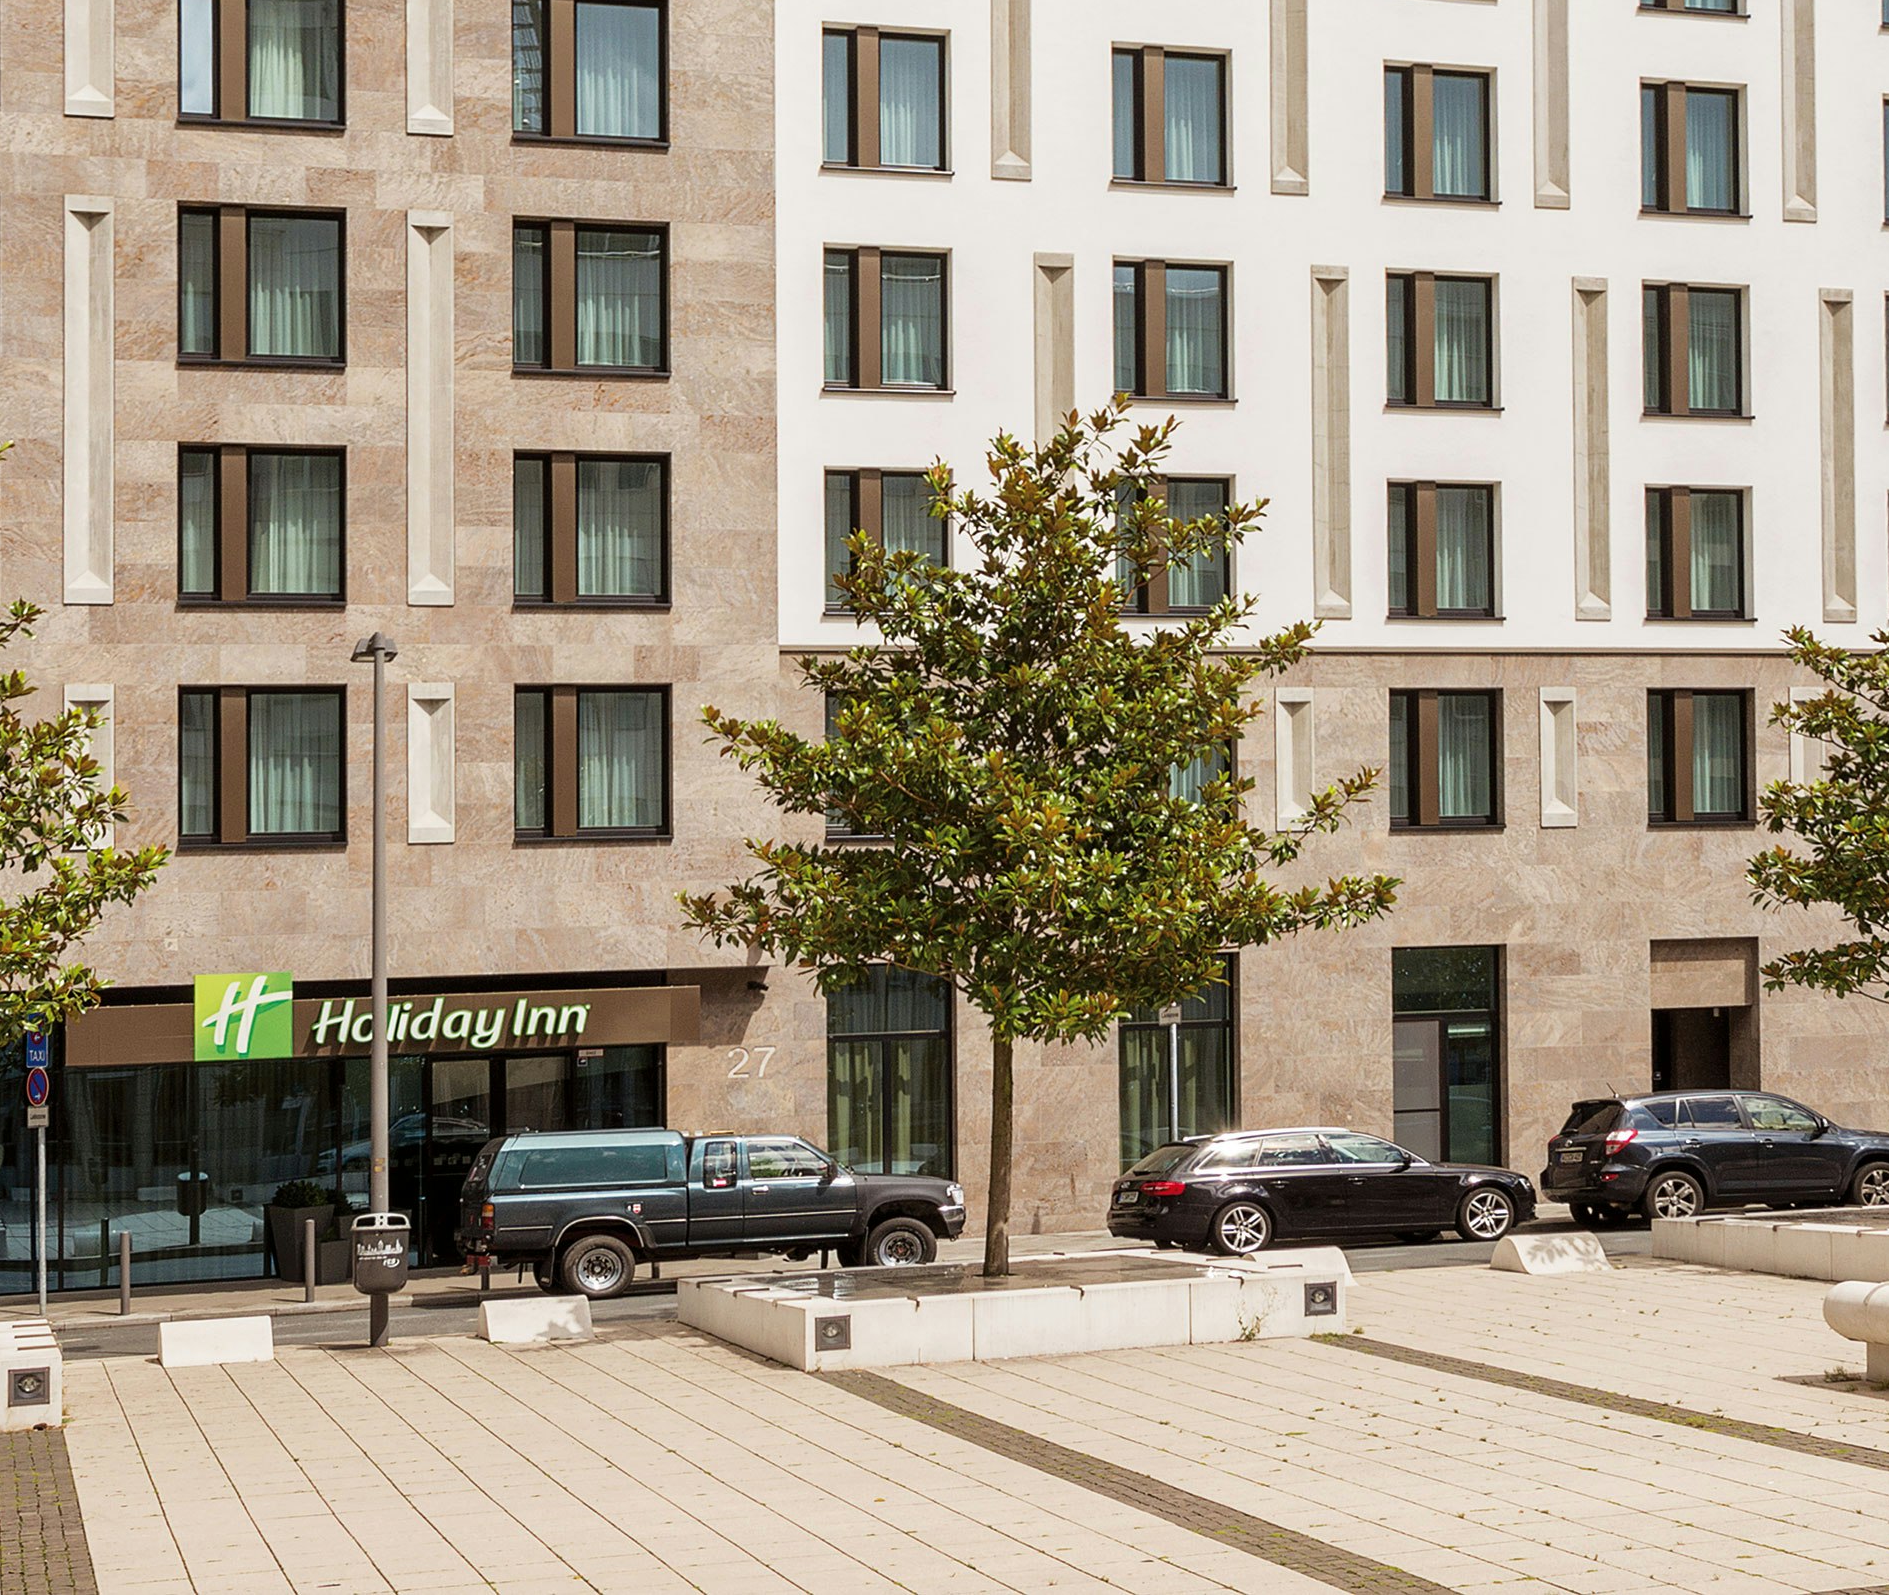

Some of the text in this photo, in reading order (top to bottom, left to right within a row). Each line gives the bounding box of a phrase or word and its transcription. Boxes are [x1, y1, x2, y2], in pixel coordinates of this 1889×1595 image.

[311, 996, 589, 1049] Holiday Inn
[29, 1049, 46, 1062] TAXI
[727, 1046, 776, 1079] 27
